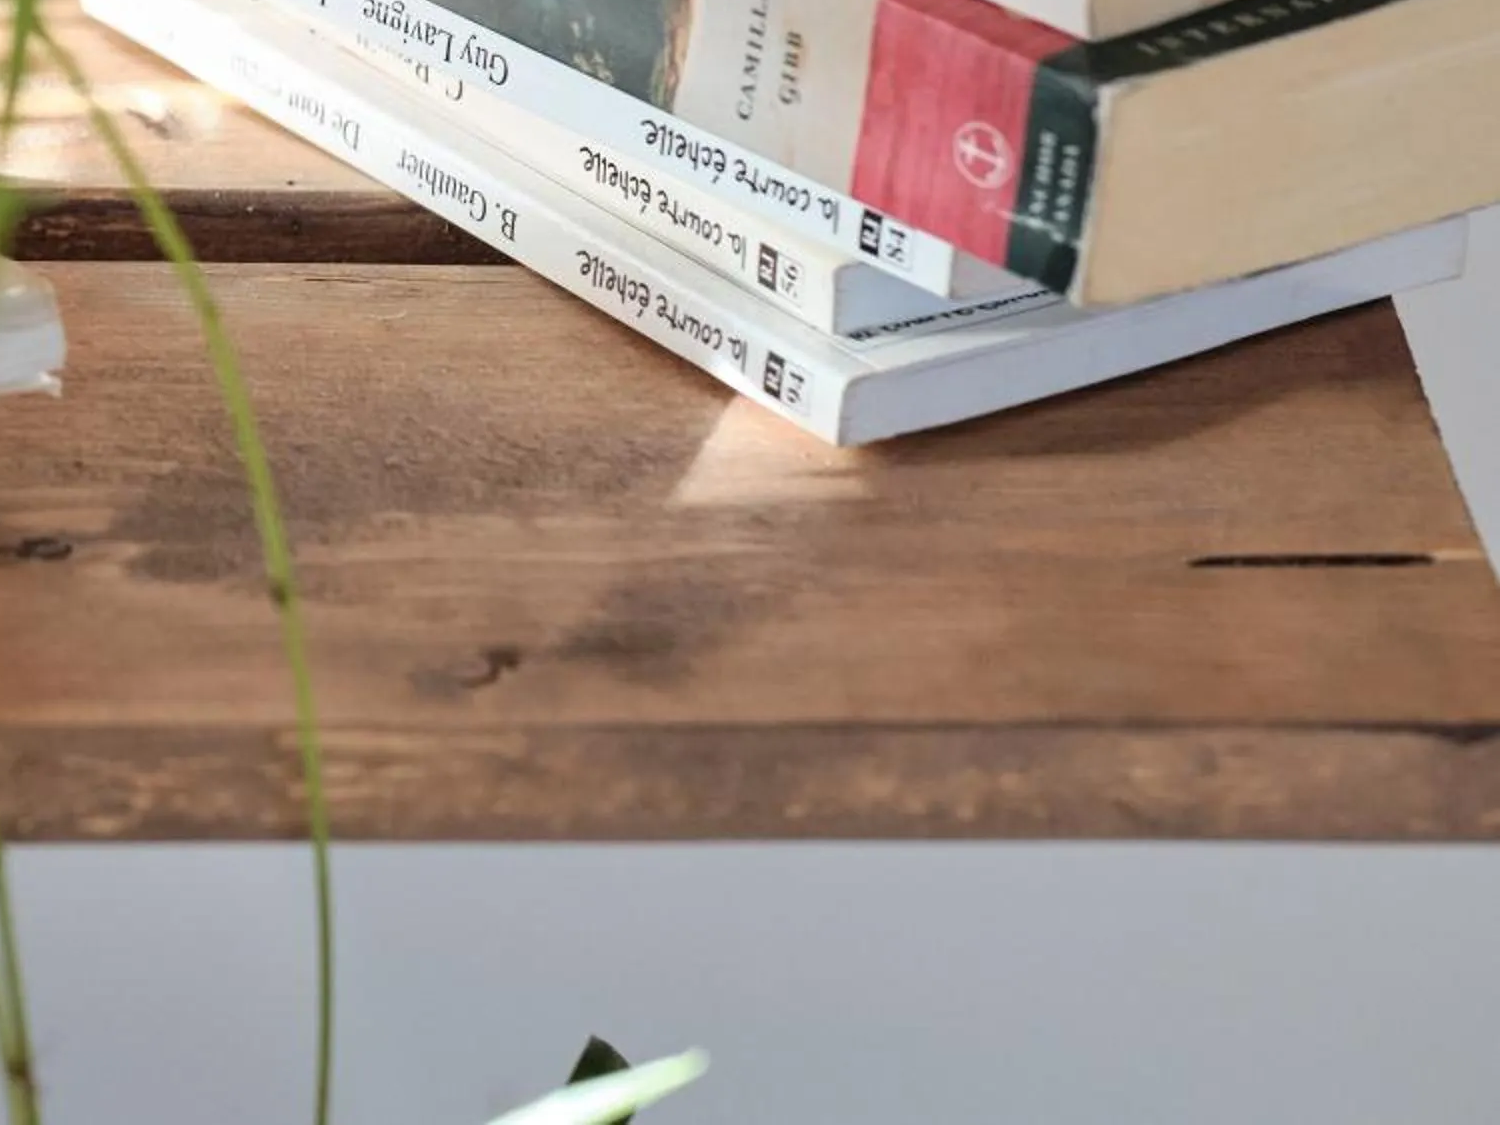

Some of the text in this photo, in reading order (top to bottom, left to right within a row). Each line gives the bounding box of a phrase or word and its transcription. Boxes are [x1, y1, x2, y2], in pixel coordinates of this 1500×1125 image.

[459, 33, 510, 86] Guy
[778, 30, 804, 105] GIBB
[396, 148, 519, 252] B. Gauthier
[578, 145, 748, 271] la courte échelle
[639, 118, 841, 236] la courte échelle
[575, 249, 749, 377] la courte échelle
